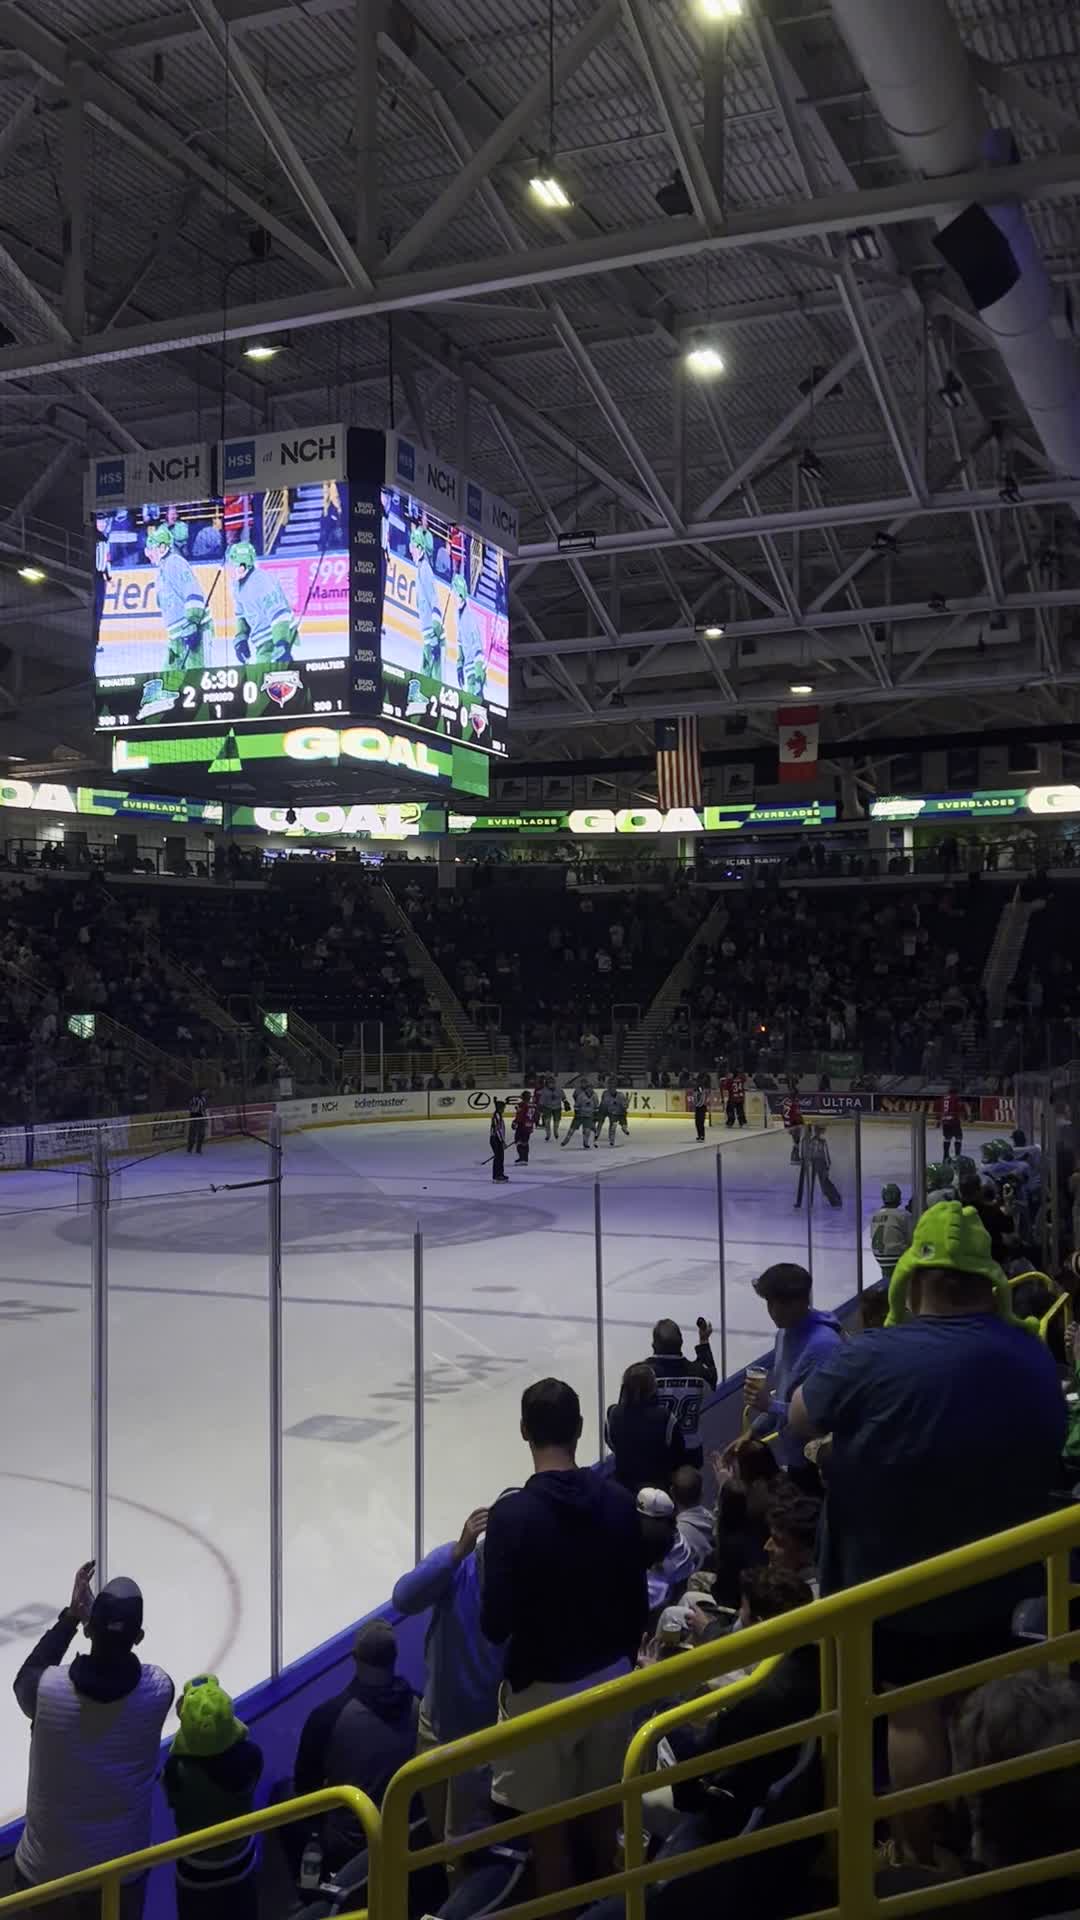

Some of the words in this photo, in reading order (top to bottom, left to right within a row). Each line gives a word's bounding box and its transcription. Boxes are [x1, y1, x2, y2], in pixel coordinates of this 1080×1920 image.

[228, 454, 252, 467] HSS
[280, 436, 336, 466] NCH
[148, 456, 200, 484] NCH
[427, 463, 456, 500] NCH
[492, 503, 517, 538] NCH
[354, 566, 376, 574] LIGHT
[305, 660, 345, 672] PENALTIES
[99, 678, 136, 688] PENALTIES
[200, 669, 239, 691] 6:30
[182, 686, 196, 708] 2
[203, 692, 234, 703] PERIOD
[243, 681, 258, 704] 0
[214, 704, 222, 718] 1
[336, 700, 343, 710] 1
[430, 695, 438, 718] 2
[460, 706, 468, 728] 0
[112, 740, 150, 773] L
[283, 726, 440, 777] GOAL
[122, 800, 189, 813] EVERBLADES
[937, 798, 1015, 810] EVERBLADES
[568, 803, 757, 834] GOAL
[750, 808, 821, 819] EVERBLADES
[487, 818, 557, 826] EVERBLADES
[320, 1101, 339, 1113] NCH
[354, 1097, 405, 1109] ticketmaster
[822, 1097, 863, 1108] ULTRA
